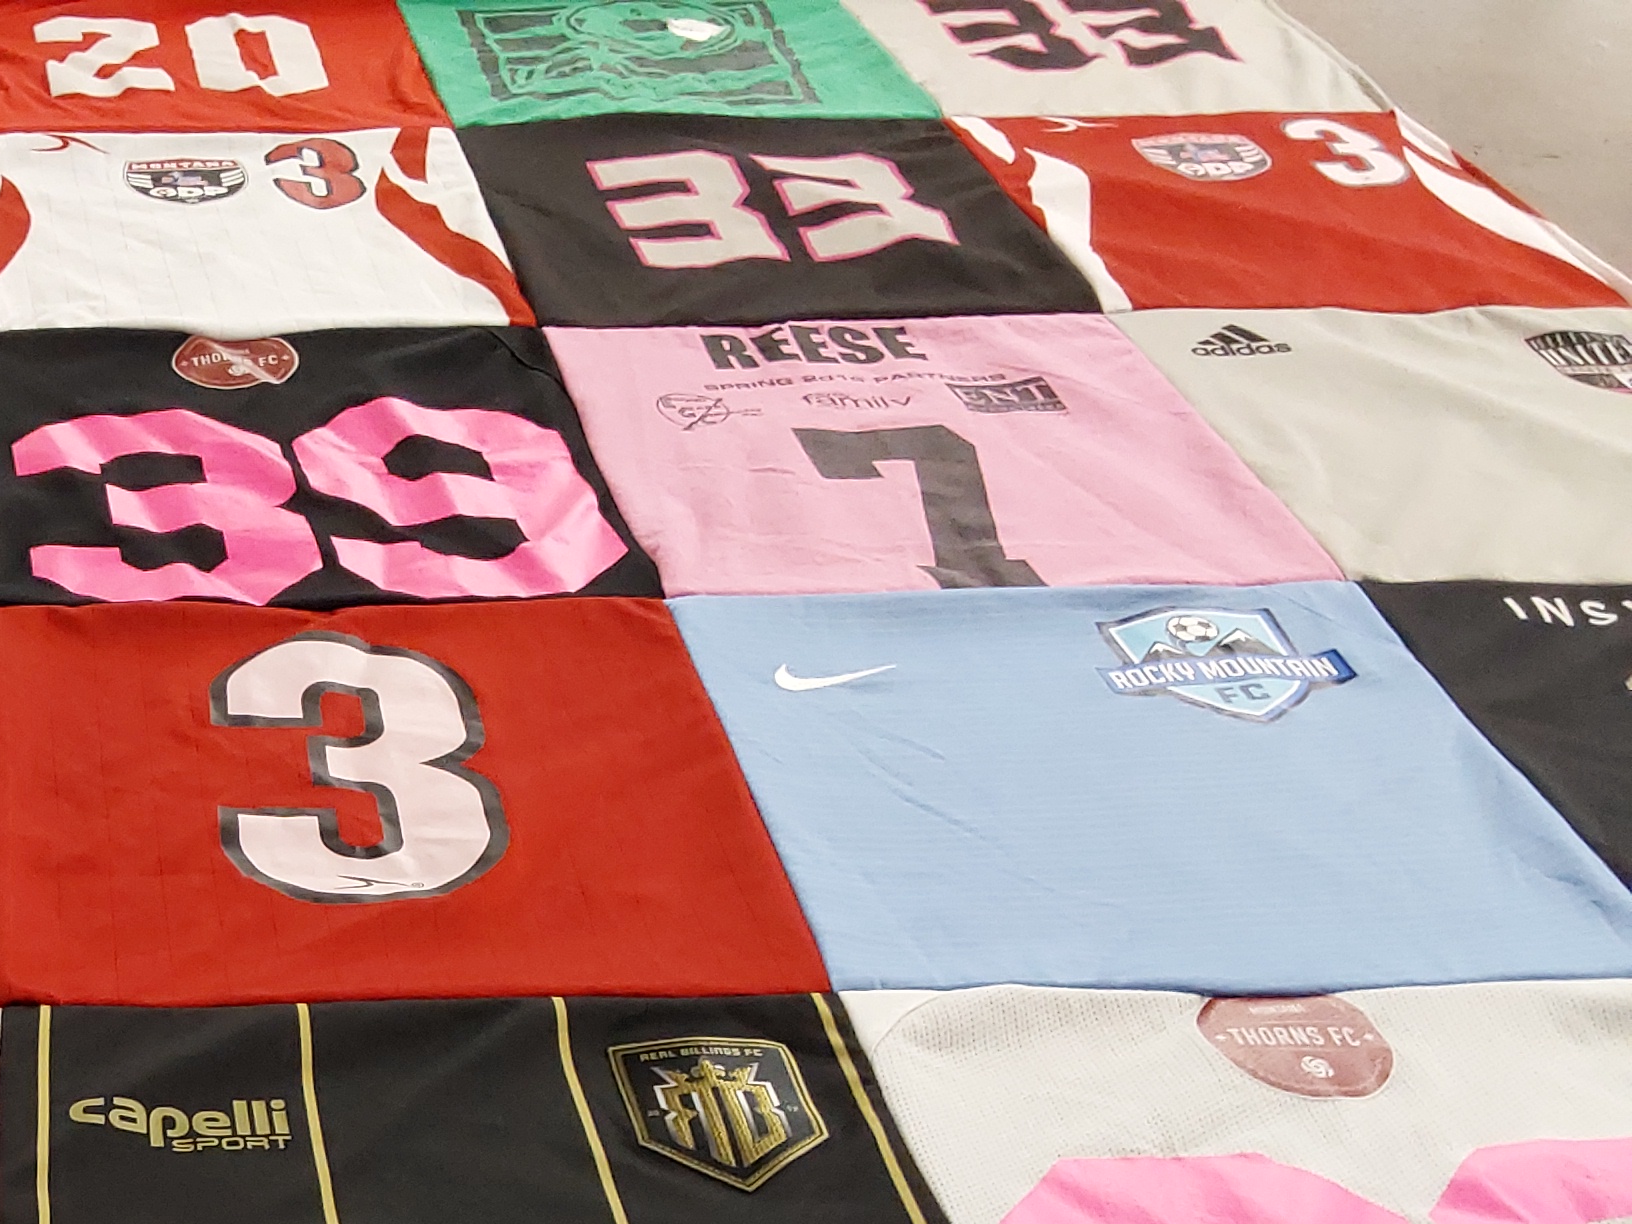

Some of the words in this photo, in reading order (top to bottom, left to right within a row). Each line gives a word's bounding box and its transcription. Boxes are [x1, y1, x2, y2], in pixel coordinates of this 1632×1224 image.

[33, 12, 330, 98] 20
[264, 137, 367, 210] 3
[1279, 118, 1411, 188] 3
[585, 148, 961, 269] 33
[258, 354, 279, 367] FC
[700, 324, 929, 370] REESE
[1190, 340, 1293, 358] adidas
[702, 377, 794, 391] SPRING
[10, 396, 629, 607] 39
[790, 424, 1050, 590] 7
[1108, 661, 1196, 690] ROCKY
[1196, 656, 1339, 681] MOUNTAIN
[1215, 682, 1272, 704] FC
[209, 629, 510, 905] 3
[743, 1047, 764, 1057] FC
[1226, 1025, 1325, 1047] THORNS
[1326, 1026, 1362, 1048] FC
[68, 1095, 291, 1148] capelli
[170, 1134, 293, 1153] SPORT
